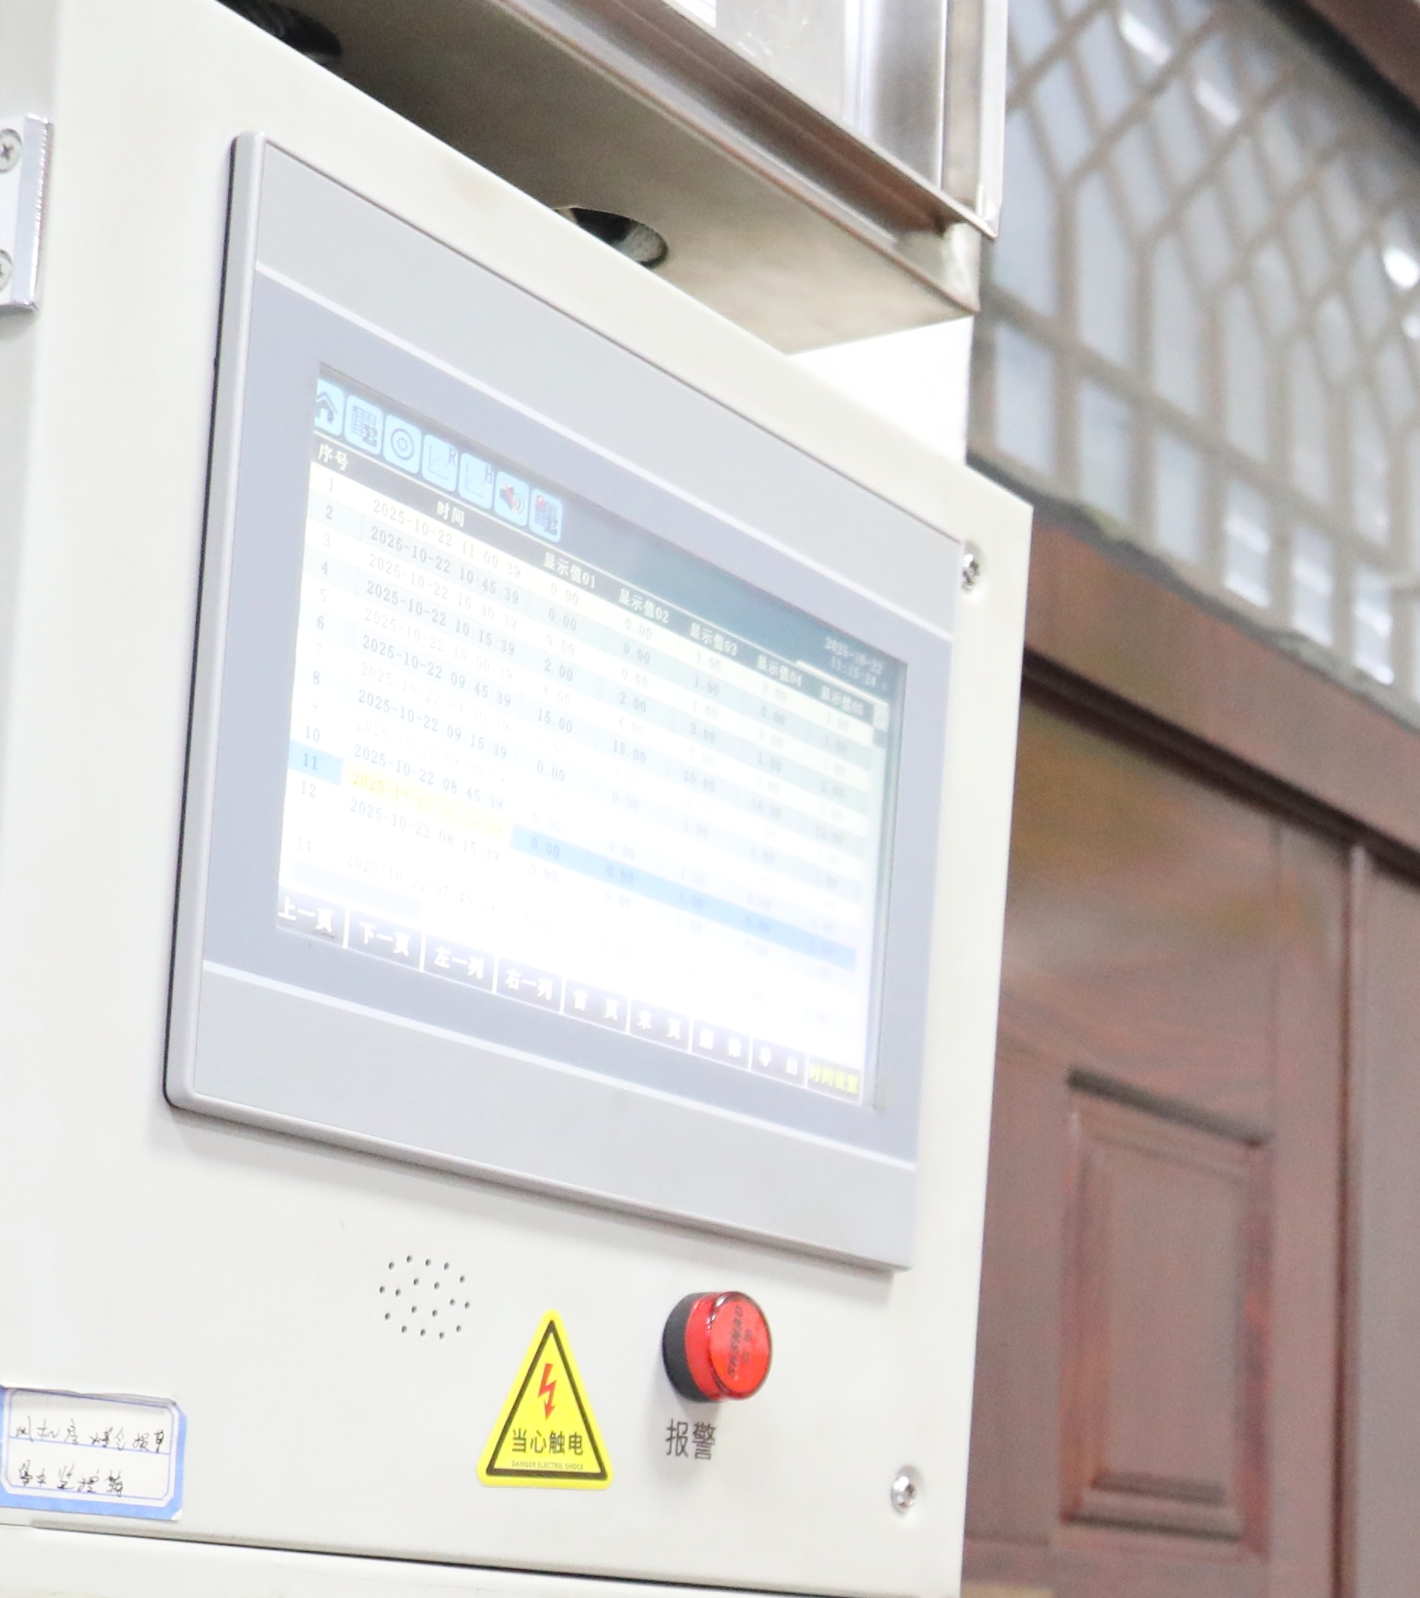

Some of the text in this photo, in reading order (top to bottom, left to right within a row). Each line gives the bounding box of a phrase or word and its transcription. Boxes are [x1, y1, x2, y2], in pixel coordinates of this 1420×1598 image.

[317, 441, 349, 472] 序号
[436, 499, 465, 527] 时间
[542, 550, 596, 589] 显示值01
[618, 587, 669, 625] 显示值02
[327, 475, 335, 494] 1
[370, 497, 453, 548] 2025-10-22
[325, 503, 333, 522] 2
[368, 524, 451, 575] 2025-10-22
[458, 565, 520, 606] 10:45:39
[547, 606, 577, 633] 0.00
[622, 640, 650, 666] 0.00
[366, 551, 449, 601] 2025-10-22
[320, 559, 329, 577] 4
[364, 578, 447, 628] 2025-10-22
[454, 618, 516, 658] 10:15:39
[544, 657, 574, 683] 2.00
[618, 690, 647, 715] 2.00
[316, 614, 325, 632] 6
[360, 633, 443, 681] 2025-10-22
[450, 670, 512, 709] 09:45:39
[536, 706, 573, 735] 15.00
[611, 738, 646, 765] 15.00
[304, 723, 321, 745] 10
[352, 742, 435, 787] 2025-10-22
[312, 670, 320, 688] 8
[356, 687, 439, 734] 2025-10-22
[446, 723, 508, 761] 09:15:39
[536, 759, 566, 784] 0.00
[302, 751, 319, 772] 11
[348, 796, 431, 840] 2025-10-22
[277, 894, 334, 934] 上一页
[357, 919, 411, 958] 下一页
[433, 942, 486, 980] 左一列
[504, 964, 554, 1001] 右一列
[511, 1427, 584, 1456] 当心触电
[511, 1460, 536, 1468] DANGER
[537, 1461, 564, 1470] ELECTRIC
[665, 1419, 717, 1461] 报警
